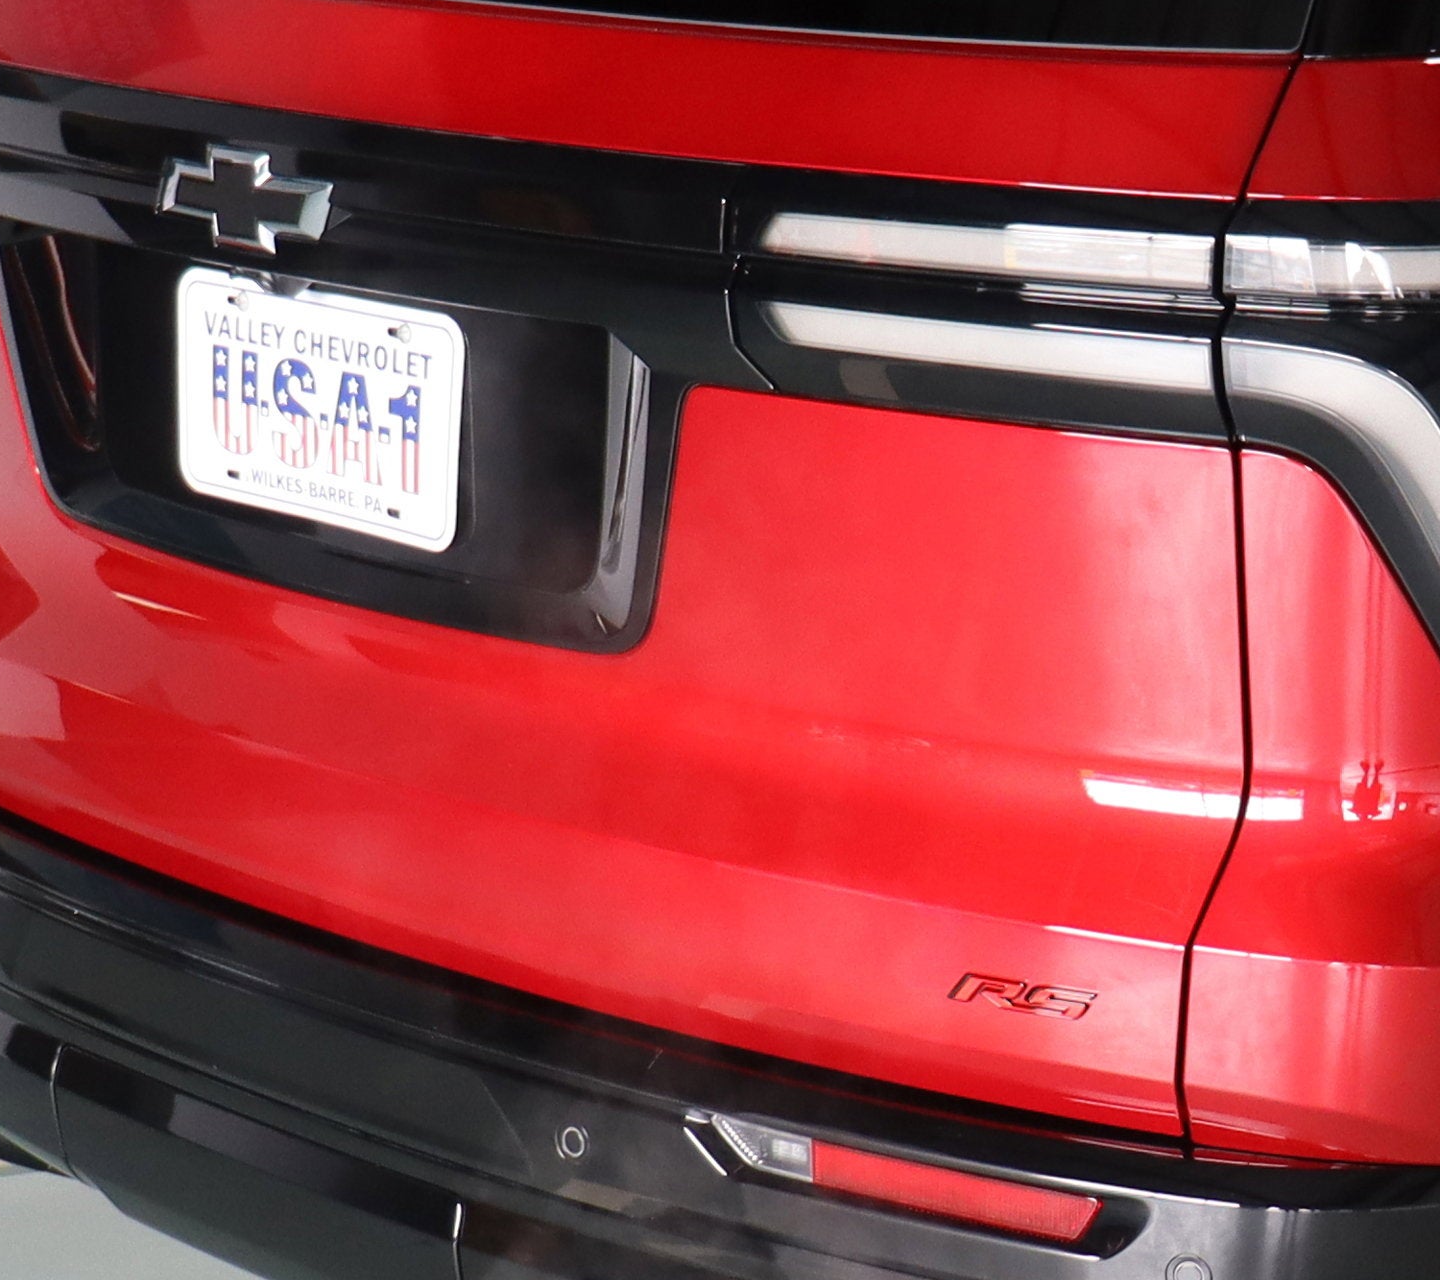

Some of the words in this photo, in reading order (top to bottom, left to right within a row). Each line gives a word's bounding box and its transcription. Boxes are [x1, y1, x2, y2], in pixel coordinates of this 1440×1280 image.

[204, 310, 285, 350] VALLEY
[293, 329, 433, 380] CHEVROLET
[364, 495, 383, 513] PA
[946, 971, 1100, 1022] RS
